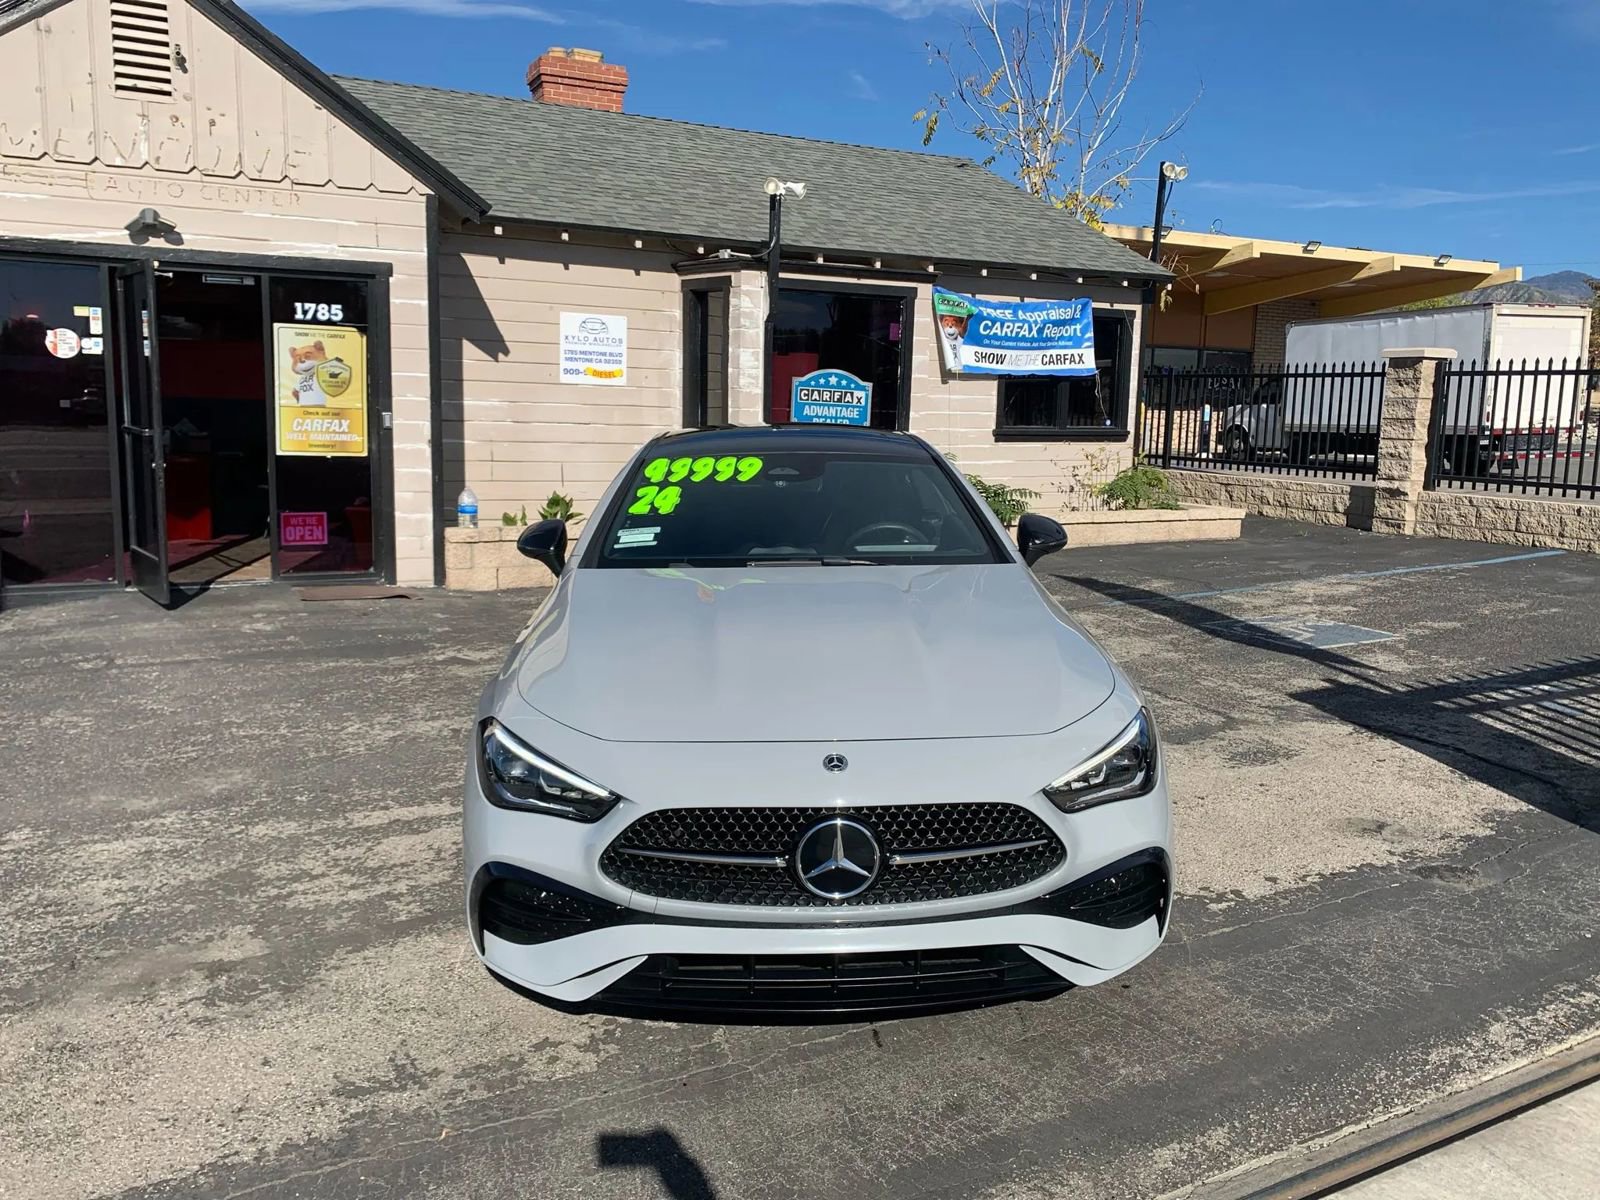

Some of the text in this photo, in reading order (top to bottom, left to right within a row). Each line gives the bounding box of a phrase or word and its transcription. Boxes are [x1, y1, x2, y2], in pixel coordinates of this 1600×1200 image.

[294, 302, 344, 321] 1785
[1018, 303, 1074, 324] Appraisal
[1074, 304, 1082, 319] &
[979, 320, 1082, 340] CARFAX Report
[974, 350, 1007, 365] SHOW
[1041, 353, 1085, 366] CARFAX
[800, 389, 863, 405] CARFAX
[803, 405, 859, 418] ADVANTAGE
[292, 417, 351, 432] CARFAX
[643, 456, 764, 483] 49999
[627, 485, 682, 515] 24
[285, 526, 323, 541] OPEN
